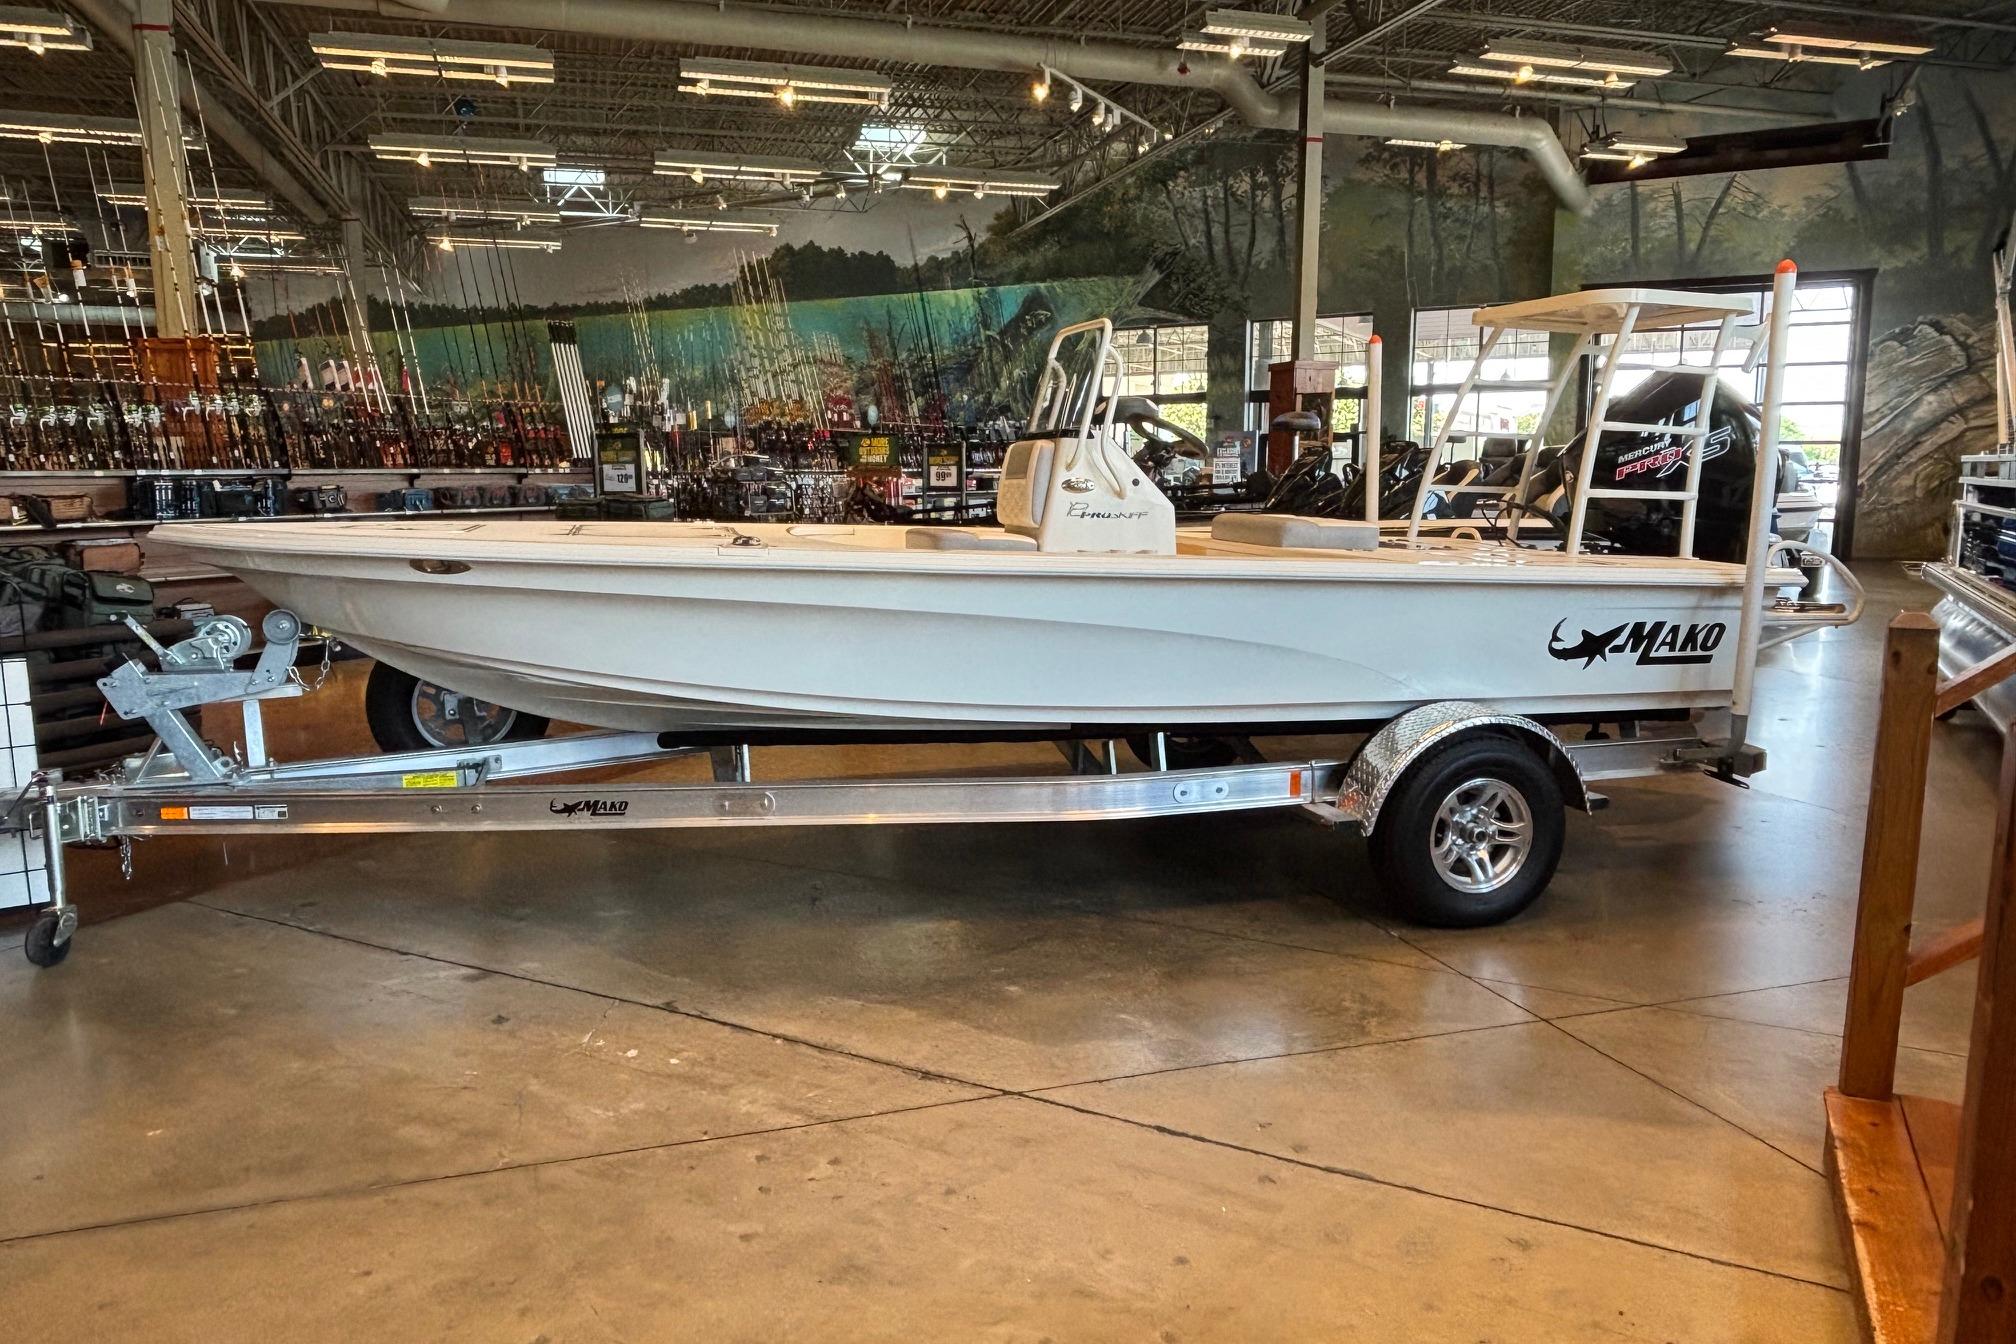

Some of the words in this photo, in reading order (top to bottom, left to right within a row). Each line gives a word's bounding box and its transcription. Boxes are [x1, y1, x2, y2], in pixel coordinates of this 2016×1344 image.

[1617, 438, 1672, 463] MERCURY
[1609, 621, 1727, 665] MAKO
[577, 800, 629, 816] MAKO
